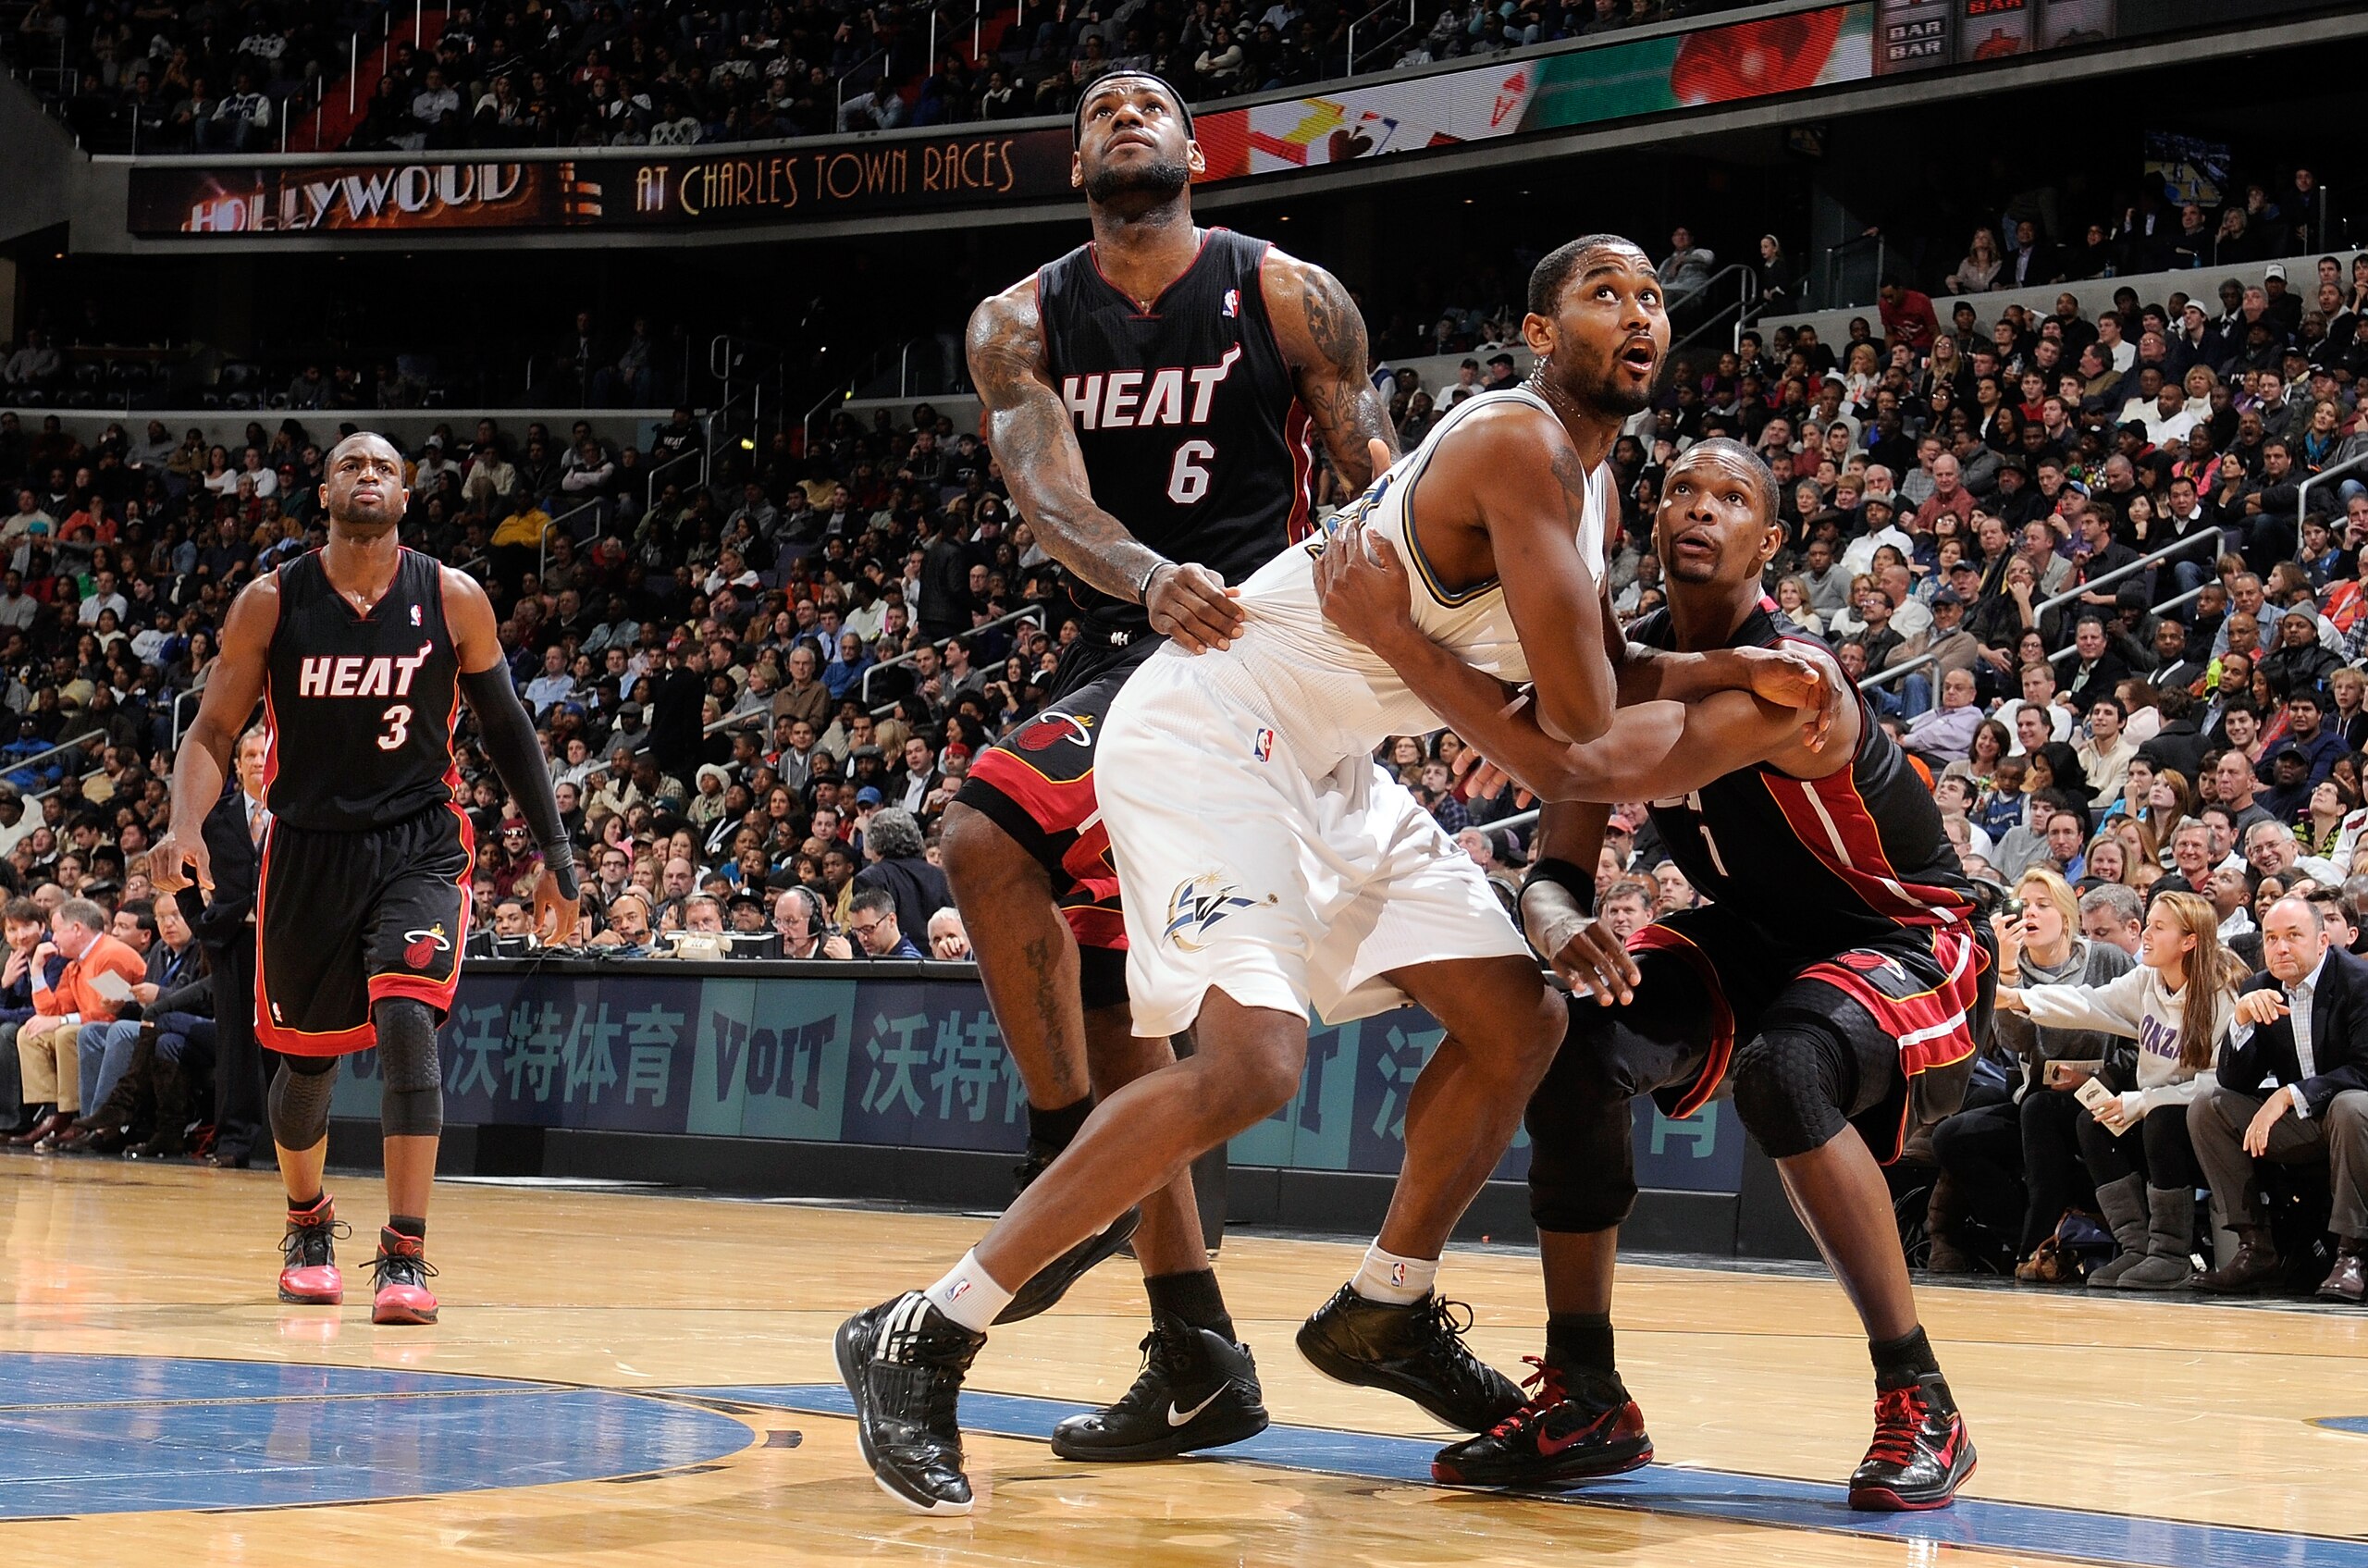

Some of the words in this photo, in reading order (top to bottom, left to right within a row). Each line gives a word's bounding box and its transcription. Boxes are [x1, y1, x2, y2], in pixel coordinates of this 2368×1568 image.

[1889, 20, 1942, 41] BAR
[1889, 40, 1942, 60] BAR
[636, 166, 668, 212] AT
[680, 158, 798, 216] CHARLES
[815, 148, 907, 200] TOWN
[925, 141, 1015, 192] RACES
[1063, 341, 1242, 431] HEAT
[1166, 439, 1215, 504] 6
[298, 638, 434, 698] HEAT
[376, 704, 413, 751] 3
[447, 1001, 684, 1107] 沃特体育
[712, 1010, 837, 1111] VOIT
